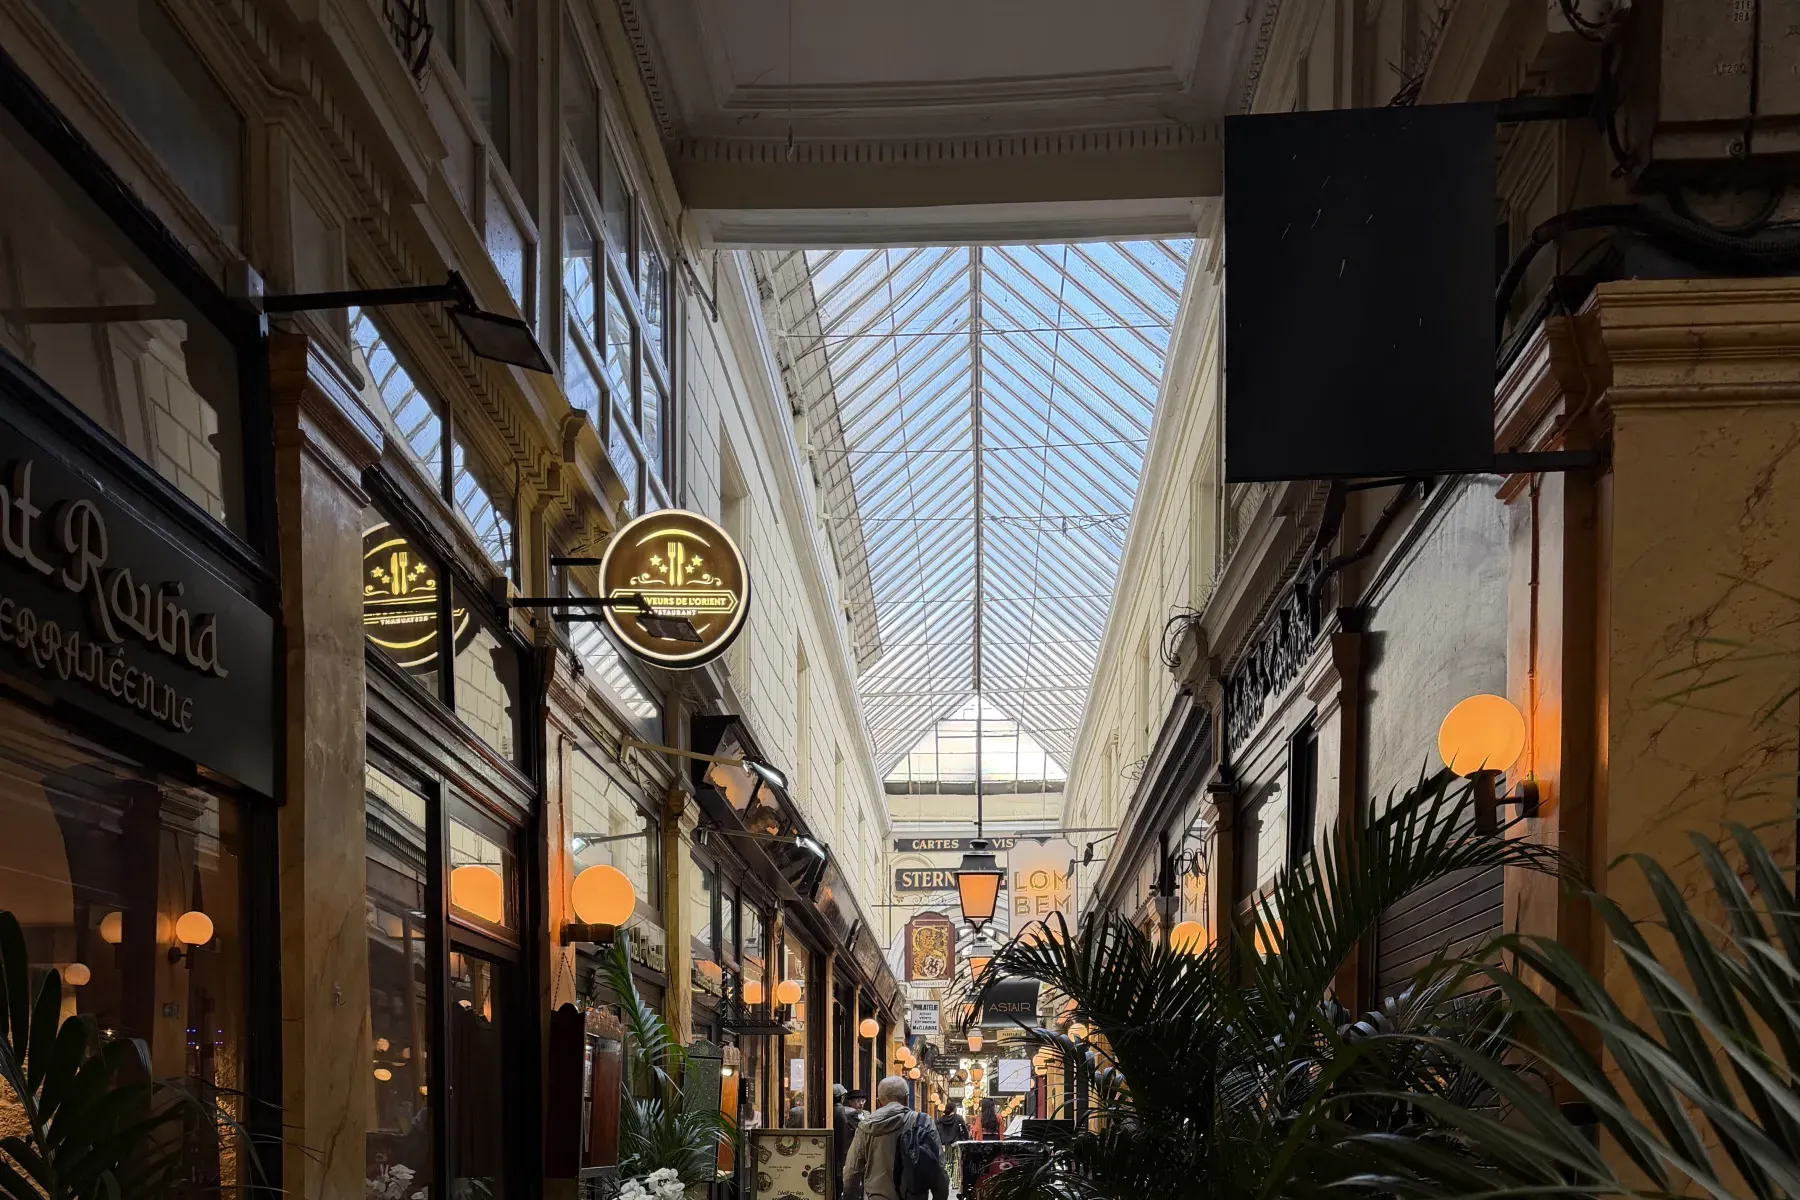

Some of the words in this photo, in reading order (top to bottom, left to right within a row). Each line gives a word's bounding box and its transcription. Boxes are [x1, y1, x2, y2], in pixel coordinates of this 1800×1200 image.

[676, 597, 689, 606] DE
[689, 597, 727, 606] L'ORIENT
[912, 839, 959, 850] CARTES
[902, 871, 957, 888] STERN
[1014, 869, 1070, 892] LOM
[1014, 895, 1072, 917] BEM
[989, 1002, 1031, 1012] ASTAIR
